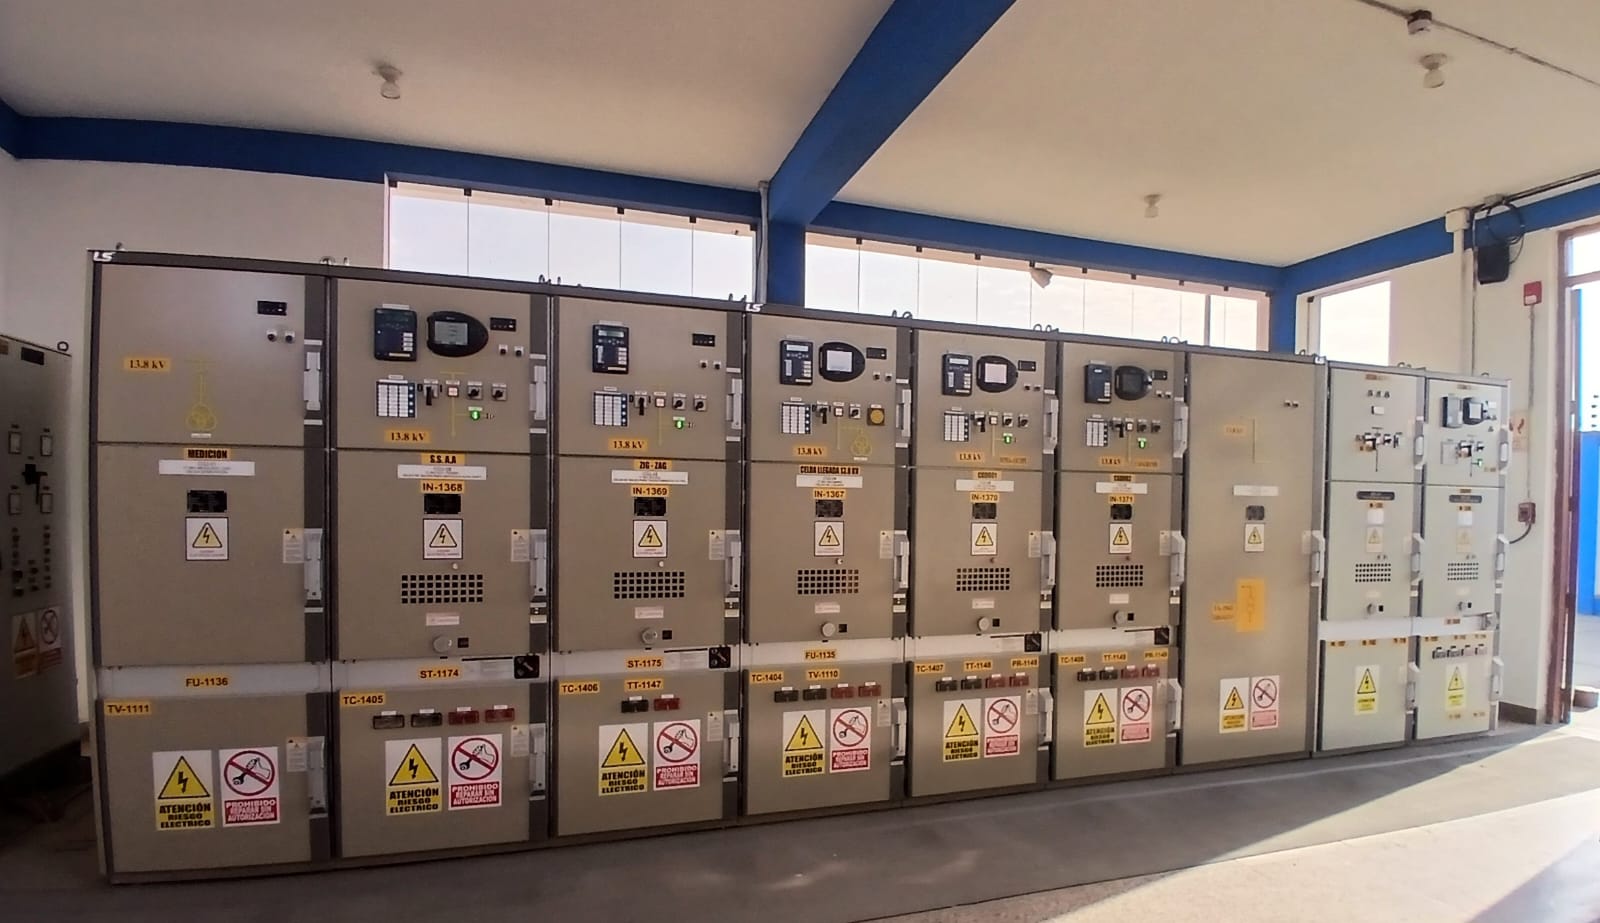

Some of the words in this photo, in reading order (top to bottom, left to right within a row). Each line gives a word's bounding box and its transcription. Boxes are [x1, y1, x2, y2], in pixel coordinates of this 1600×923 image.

[93, 251, 115, 262] LS
[746, 303, 763, 312] LS
[128, 360, 149, 369] 13.8
[391, 432, 409, 441] 13.8
[412, 432, 425, 441] kV
[613, 440, 630, 449] 13.8
[632, 440, 644, 449] kV
[187, 449, 228, 459] MEDICION
[422, 482, 463, 491] IN-1368
[632, 487, 668, 495] IN-1369
[814, 490, 845, 498] IN-1367
[805, 651, 836, 660] FU-1135
[627, 659, 662, 668] ST-1175
[419, 669, 459, 679] ST-1174
[751, 673, 783, 682] TC-1404
[808, 670, 839, 678] TV-1110
[185, 677, 229, 687] FU-1136
[627, 681, 662, 690] TT-1147
[562, 683, 599, 693] TC-1406
[343, 695, 384, 705] TC-1405
[106, 704, 150, 714] TV-1111
[601, 769, 646, 780] ATENCIÓN
[452, 783, 499, 793] PROHIBIDO
[389, 787, 439, 799] ATENCIÓN
[159, 802, 211, 814] ATENCIÓN
[225, 799, 276, 808] PROHIBIDO
